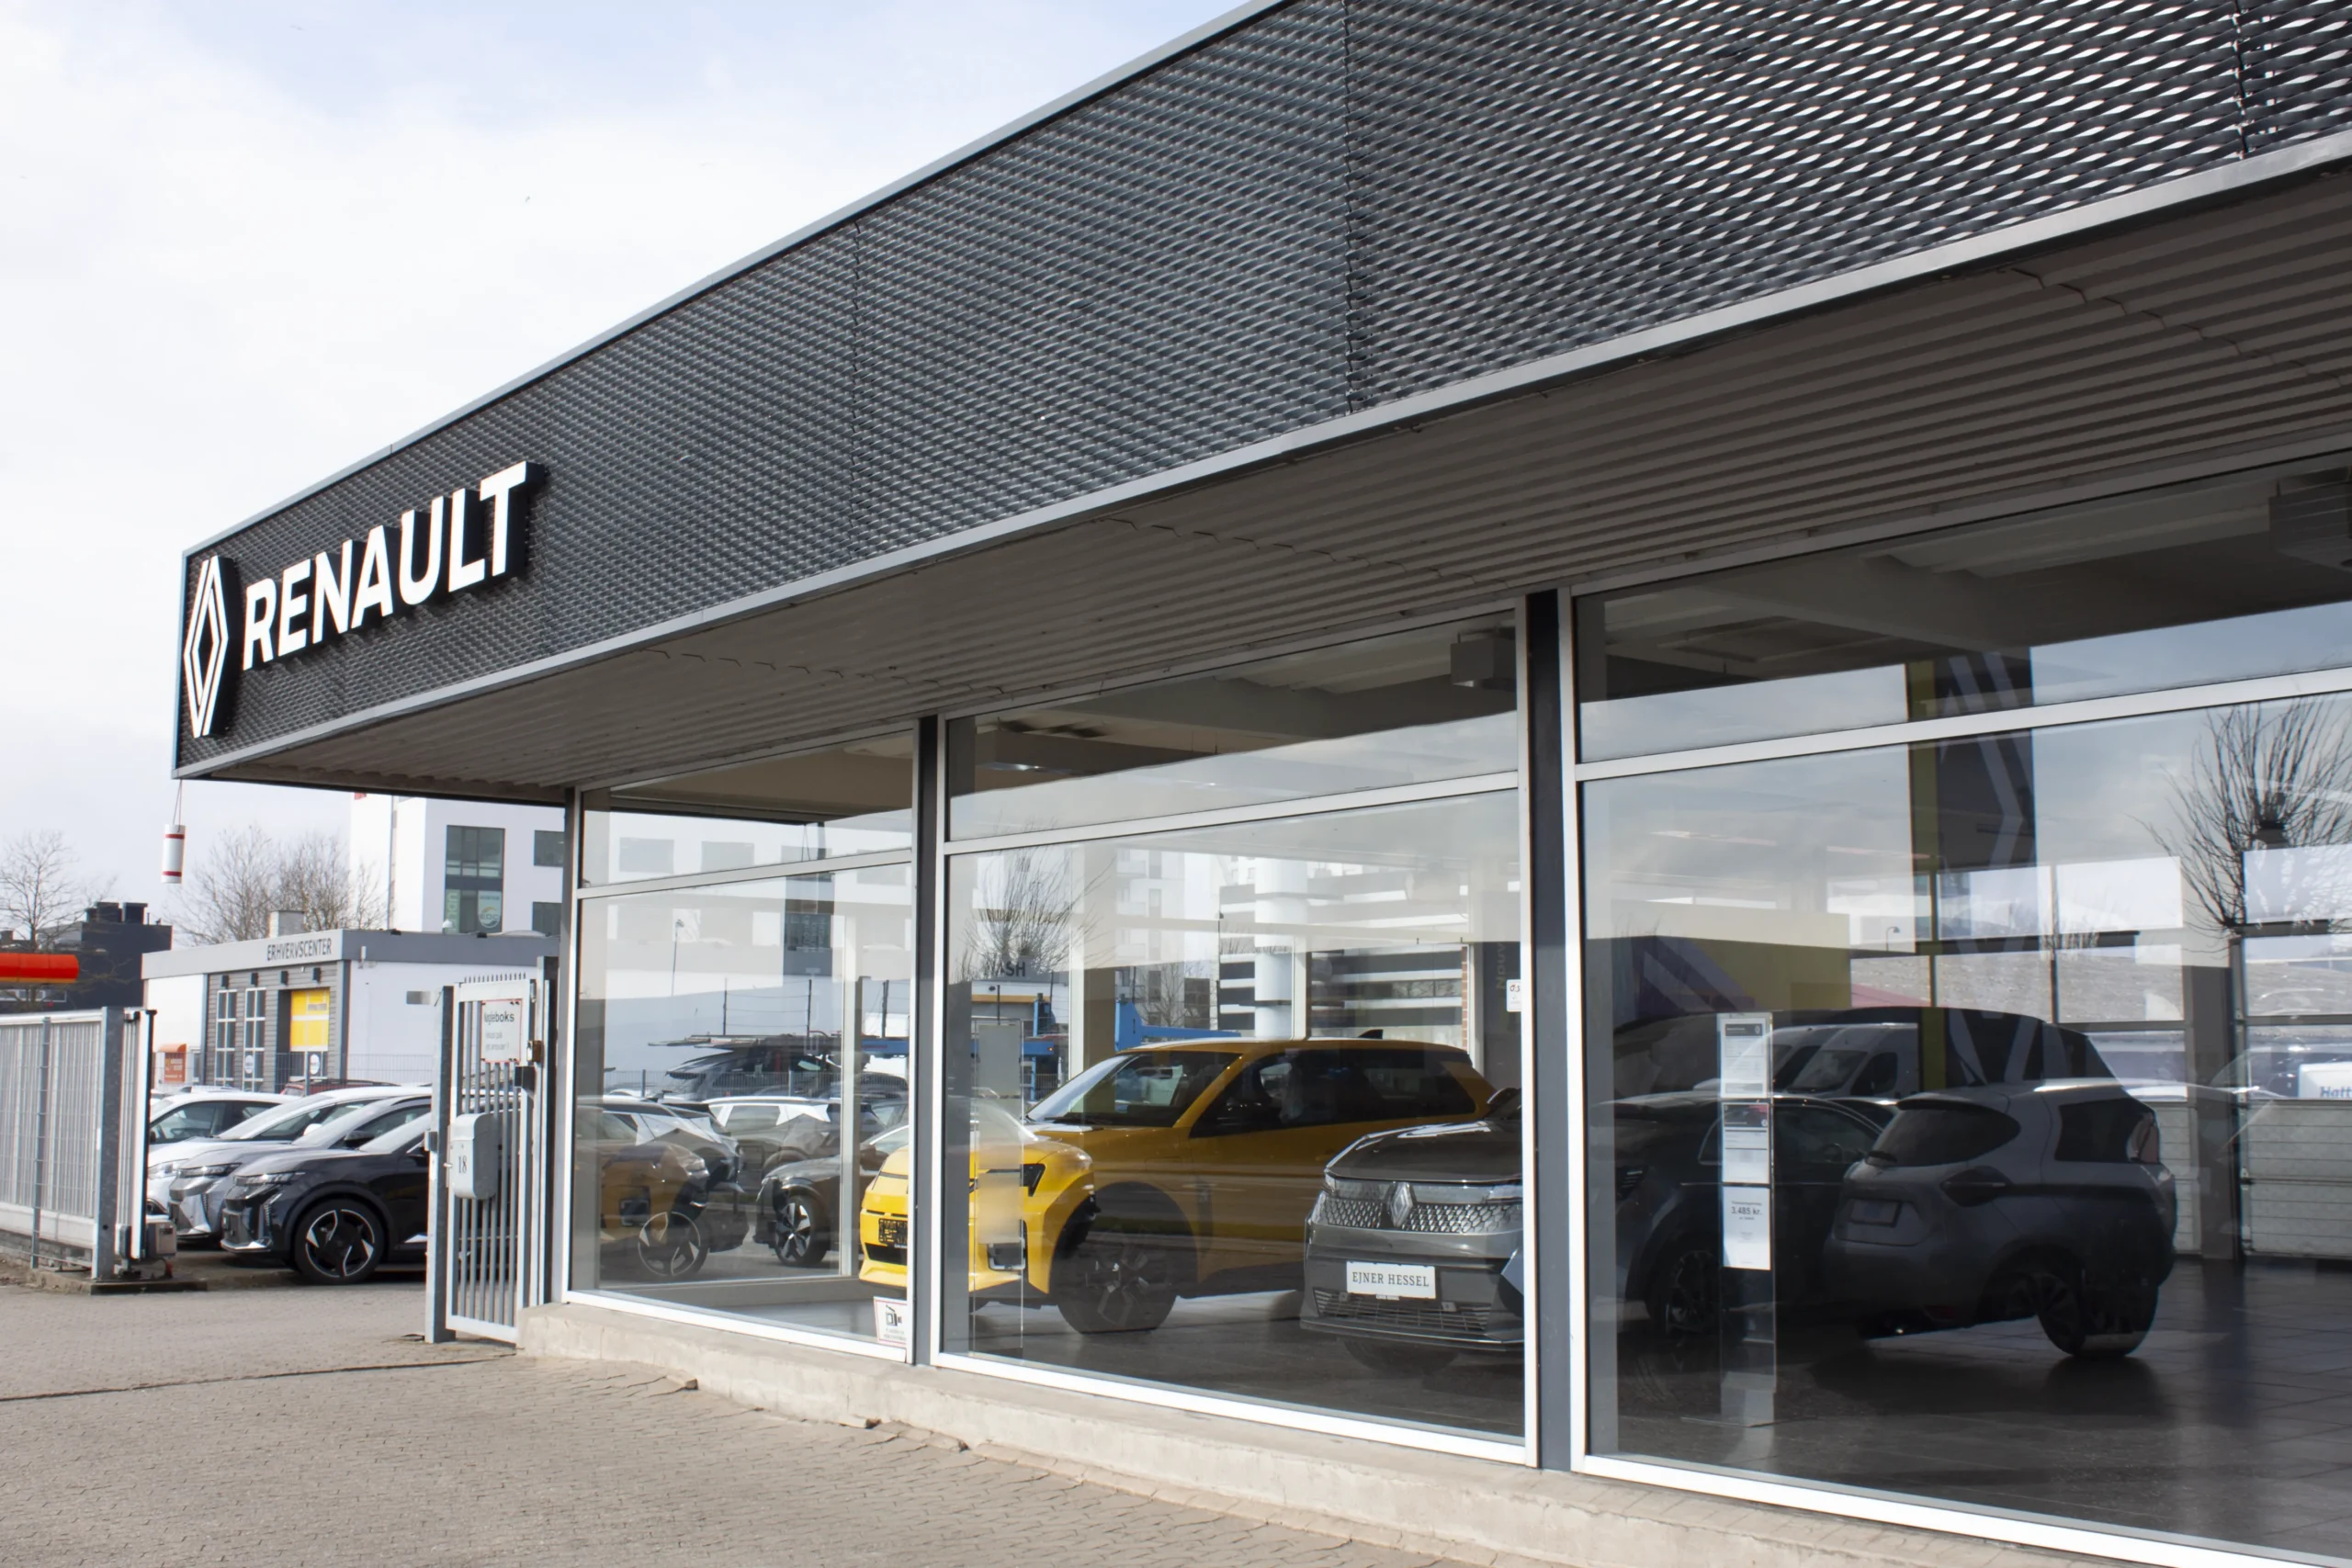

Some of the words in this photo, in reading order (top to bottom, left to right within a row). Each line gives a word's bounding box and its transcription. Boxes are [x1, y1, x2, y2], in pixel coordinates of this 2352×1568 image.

[243, 460, 527, 671] RENAULT
[267, 938, 332, 961] ERHVERVSCENTER
[458, 1155, 467, 1174] 18
[1352, 1271, 1384, 1284] EJNER
[1388, 1274, 1430, 1287] HESSEL
